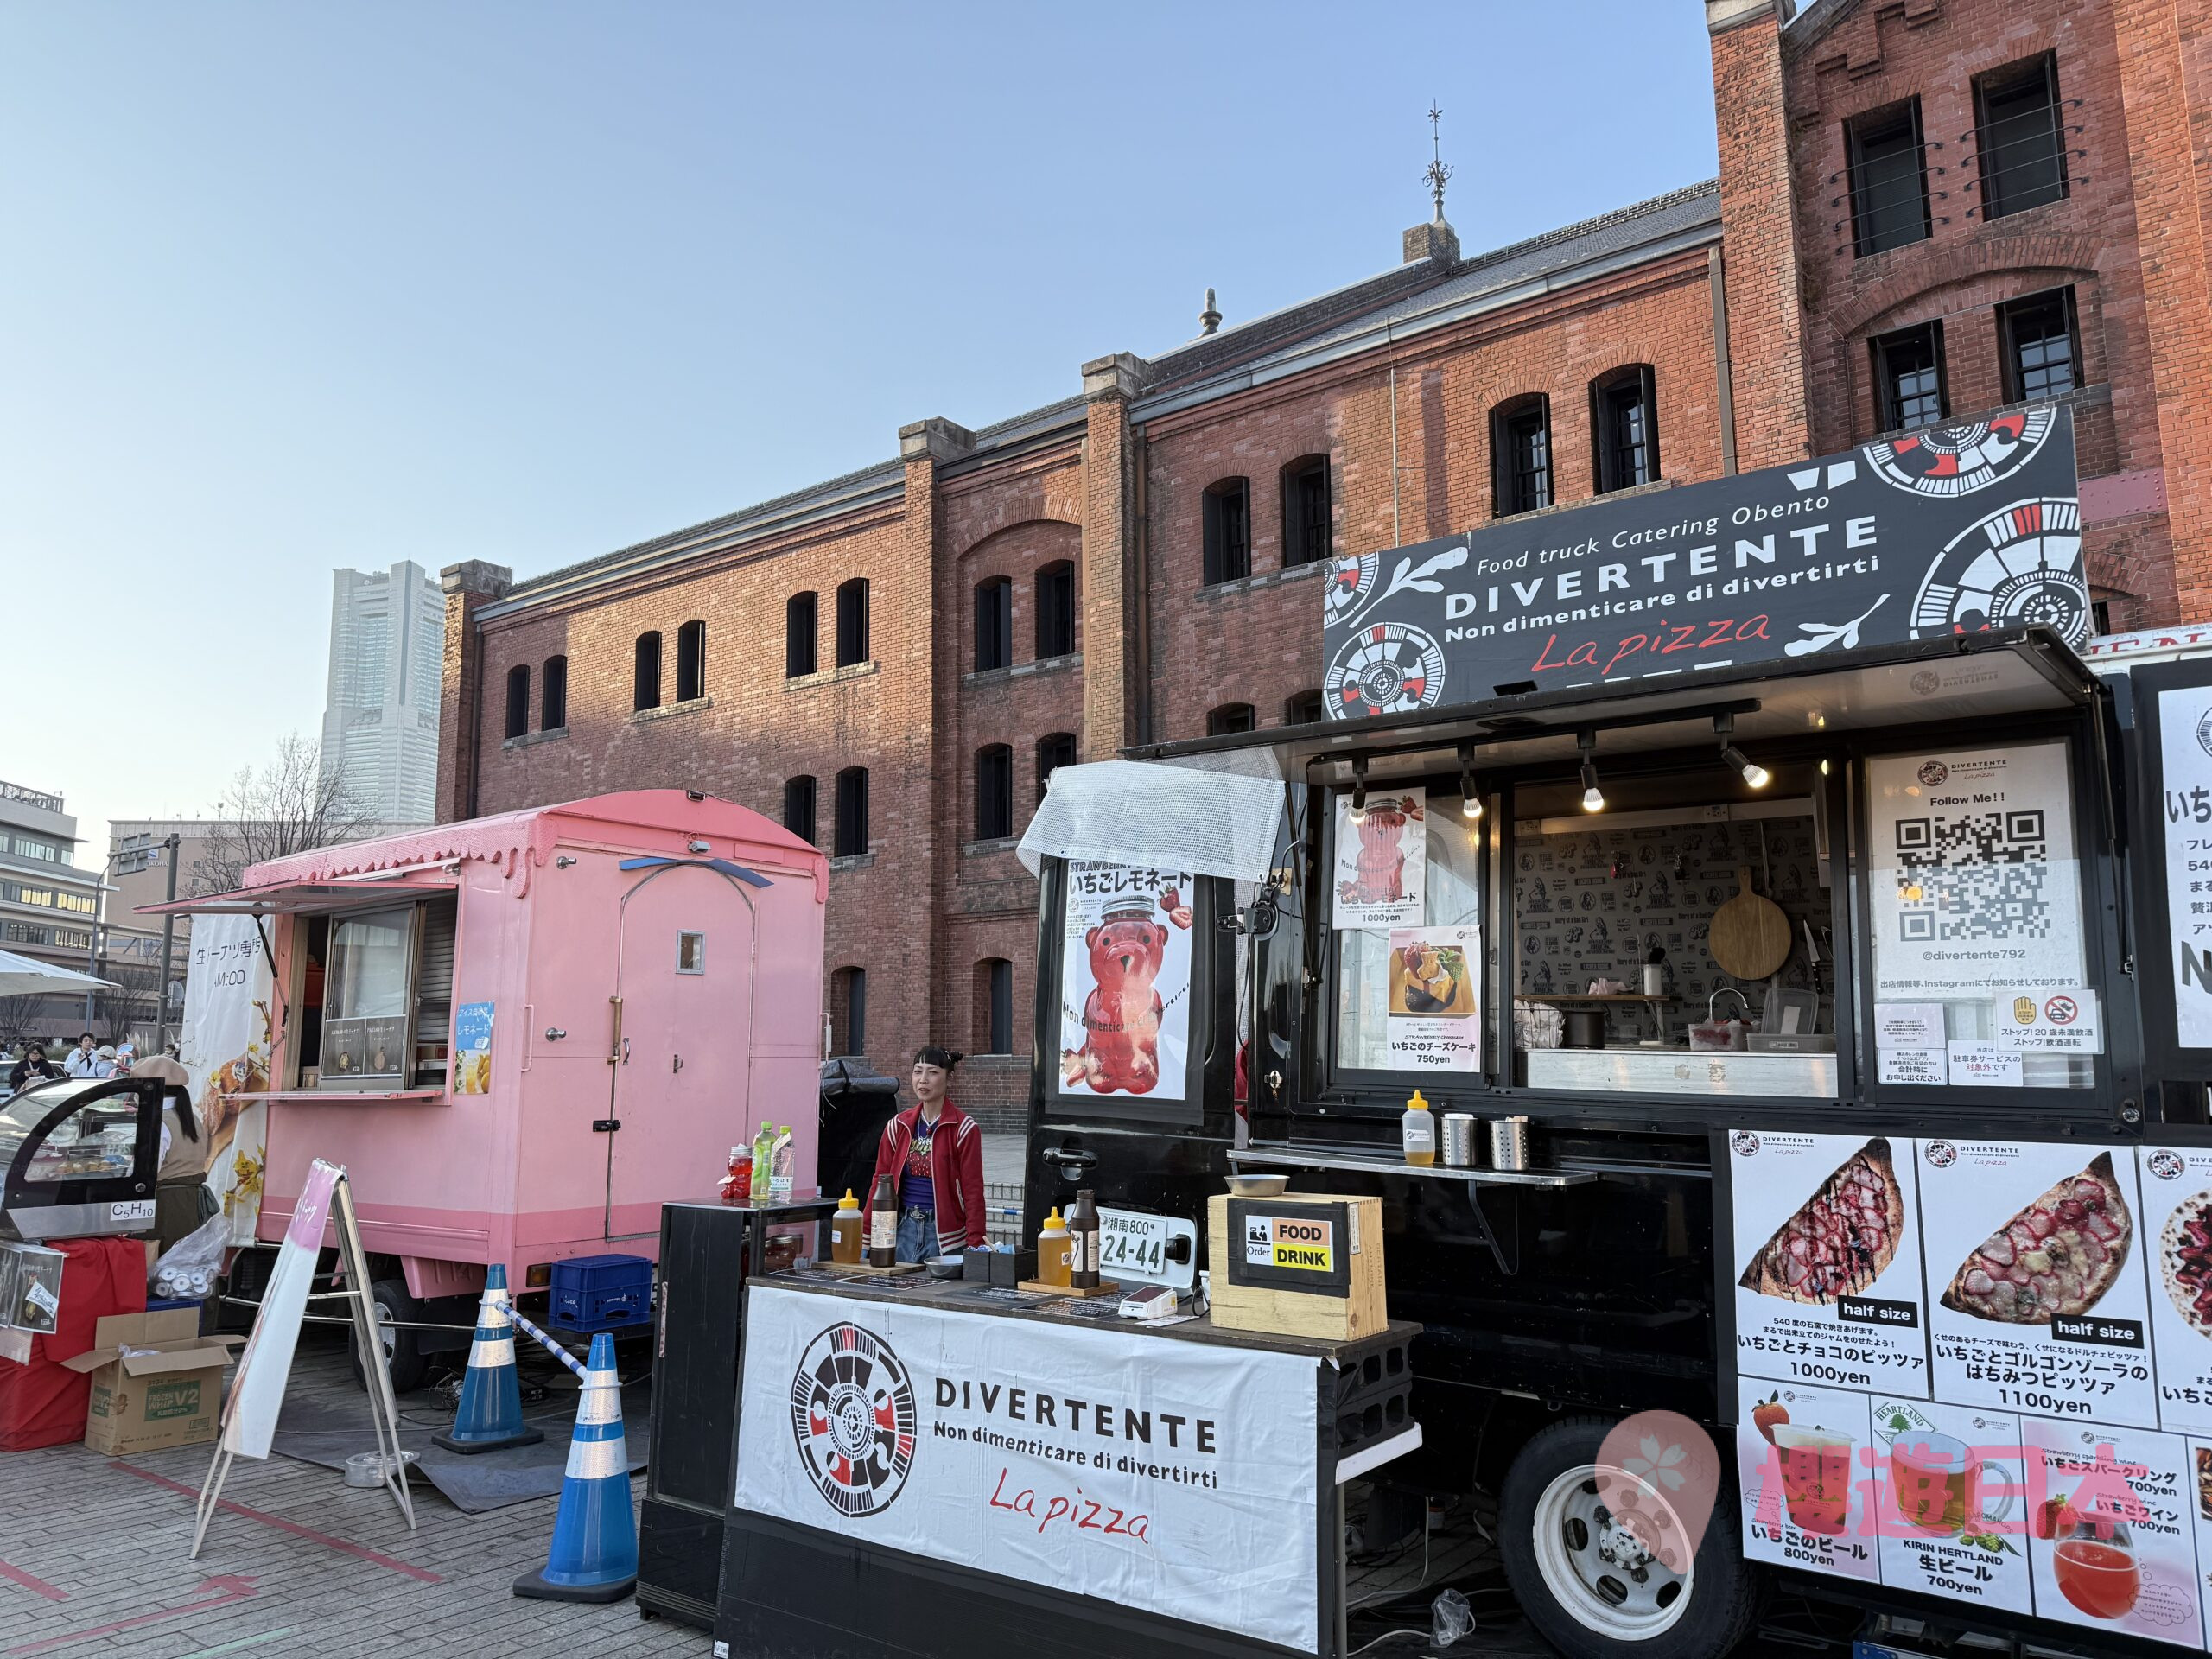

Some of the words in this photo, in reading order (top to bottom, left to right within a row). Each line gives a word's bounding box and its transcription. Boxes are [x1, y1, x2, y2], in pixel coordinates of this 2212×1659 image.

[1477, 551, 1528, 575] Food
[1539, 537, 1599, 563] truck
[1612, 517, 1719, 550] Catering
[1732, 496, 1830, 525] Obento
[1446, 516, 1877, 620] DIVERTENTE
[1446, 624, 1496, 643] Non
[1503, 593, 1675, 633] dimenticare
[1687, 584, 1713, 602] di
[1723, 555, 1879, 595] divertirti
[1531, 633, 1598, 672] La
[1601, 614, 1770, 674] pizza
[1951, 760, 2007, 769] DIVERTENTE
[1930, 796, 1969, 806] Follow
[2188, 860, 2212, 871] 54
[1923, 950, 2026, 961] @divertente792
[1063, 1001, 1079, 1024] Non
[1392, 1042, 1476, 1052] いちごのチーズケーキ
[1417, 1054, 1450, 1065] 750yen
[1279, 1224, 1322, 1241] FOOD
[1103, 1235, 1160, 1268] 24-44
[1247, 1246, 1271, 1256] Order
[1277, 1249, 1326, 1267] DRINK
[1844, 1303, 1875, 1317] half
[1879, 1309, 1911, 1321] size
[1773, 1317, 1790, 1325] 540
[1792, 1319, 1878, 1337] 度の石窯で焼きあげます。
[2057, 1320, 2094, 1336] half
[2099, 1326, 2135, 1340] size
[1738, 1334, 1924, 1369] いちごとチョコのピッツァ
[1936, 1344, 2149, 1381] いちごとゴルゴンゾーラの
[1790, 1362, 1871, 1384] 1000yen
[1967, 1363, 2116, 1395] はちみつピッツァ
[175, 1389, 199, 1406] V2
[1999, 1389, 2092, 1414] 1100yen
[935, 1377, 1216, 1454] DIVERTENTE
[1876, 1405, 1924, 1427] HEARTLAND
[933, 1421, 967, 1440] Non
[972, 1427, 1086, 1465] dimenticare
[1093, 1452, 1111, 1470] di
[1117, 1455, 1217, 1489] divertirti
[2041, 1455, 2177, 1484] いちごスパークリング
[2126, 1480, 2177, 1497] 700yen
[990, 1467, 1036, 1518] La
[1038, 1486, 1149, 1545] pizza
[2095, 1500, 2179, 1522] いちごワイン
[2129, 1518, 2180, 1535] 700yen
[1751, 1524, 1868, 1560] いちごのビール
[1903, 1539, 1935, 1553] KIRIN
[1938, 1546, 2003, 1566] HERTLAND
[1784, 1548, 1834, 1566] 800yen
[1919, 1554, 1993, 1582] 生ビール
[1927, 1574, 1983, 1595] 700yen
